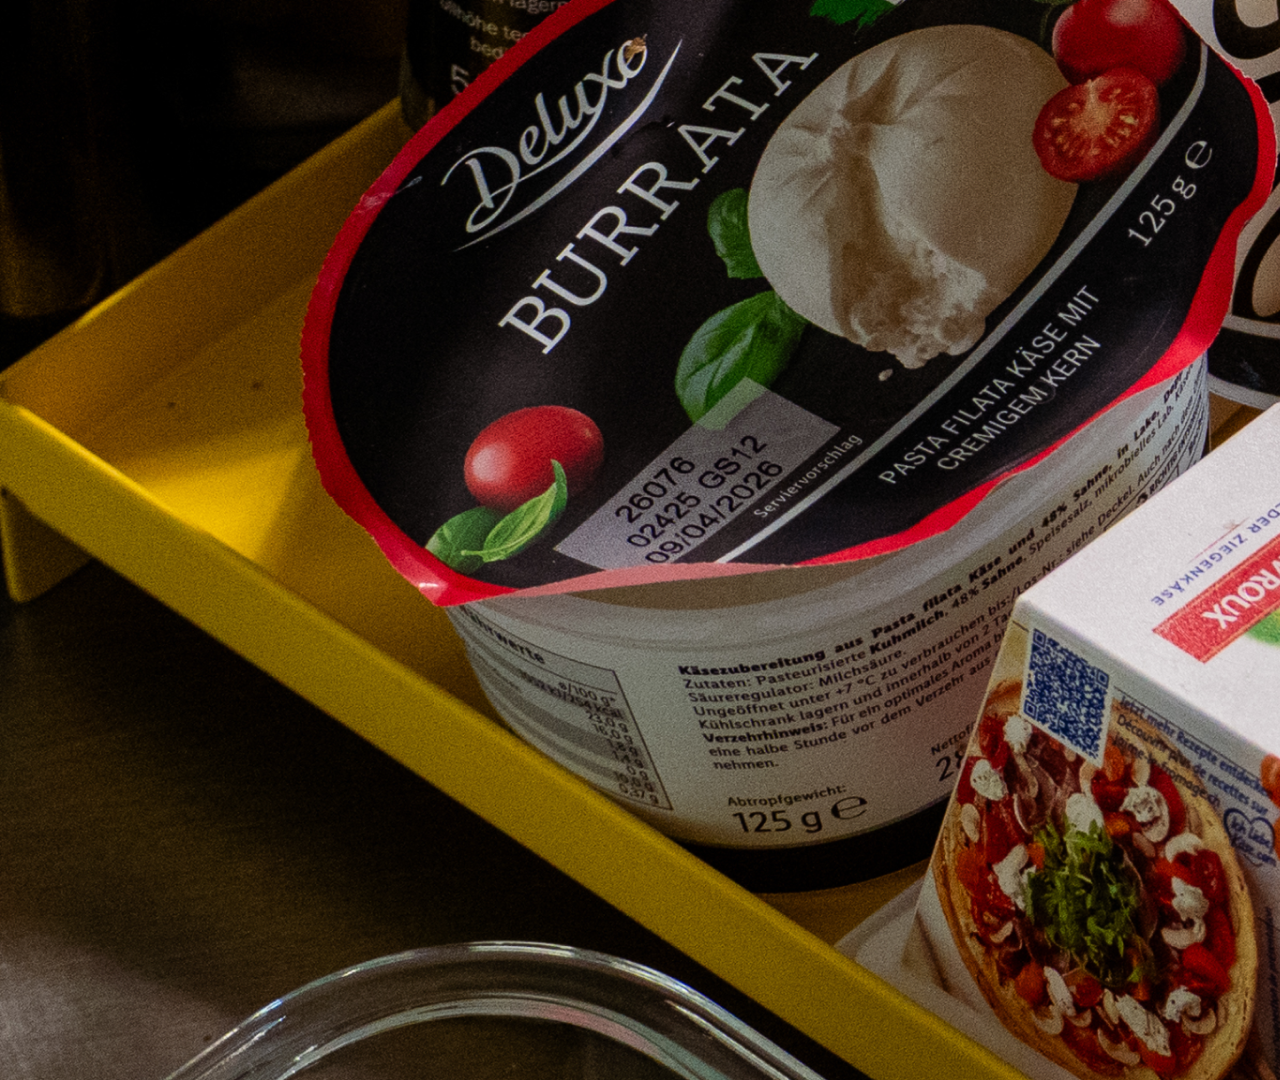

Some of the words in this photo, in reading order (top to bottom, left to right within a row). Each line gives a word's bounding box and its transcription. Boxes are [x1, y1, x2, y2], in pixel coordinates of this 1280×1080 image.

[498, 51, 819, 355] BURRATA
[1127, 193, 1177, 248] 125
[1171, 174, 1198, 200] g
[878, 435, 949, 484] PASTA
[944, 376, 1016, 434] FILATA
[1007, 321, 1068, 379] KÄSE
[1058, 284, 1100, 331] MIT
[937, 385, 1047, 471] CREMIGEM
[1041, 334, 1101, 390] KERN
[614, 456, 696, 523] 26076
[627, 491, 701, 548] 02425
[698, 434, 768, 490] GS12
[645, 460, 783, 564] 09/04/2026
[753, 433, 863, 519] Serviervorschlag
[678, 650, 826, 676] Käsezubereitung
[871, 612, 916, 639] Pasta
[922, 584, 963, 613] filata
[968, 556, 1002, 583] Käse
[1008, 528, 1036, 555] und
[1151, 533, 1248, 607] ZIEGENKÄSE
[693, 702, 786, 718] Ungeöffnet
[901, 614, 985, 670] verbrauchen
[699, 713, 796, 730] Kühlschrank
[799, 700, 850, 720] lagern
[886, 651, 952, 693] innerhalb
[755, 650, 866, 686] Pasteurisierte
[819, 650, 907, 687] Milchsäure.
[884, 672, 949, 709] optimales
[951, 641, 992, 671] Aroma
[794, 731, 848, 750] Stunde
[915, 673, 966, 707] Verzehr
[1176, 729, 1218, 766] Rezepte
[727, 783, 847, 808] Abtropfgewicht:
[732, 809, 791, 833] 125
[801, 811, 823, 834] g
[1207, 771, 1249, 804] recettes
[1250, 799, 1269, 816] sur
